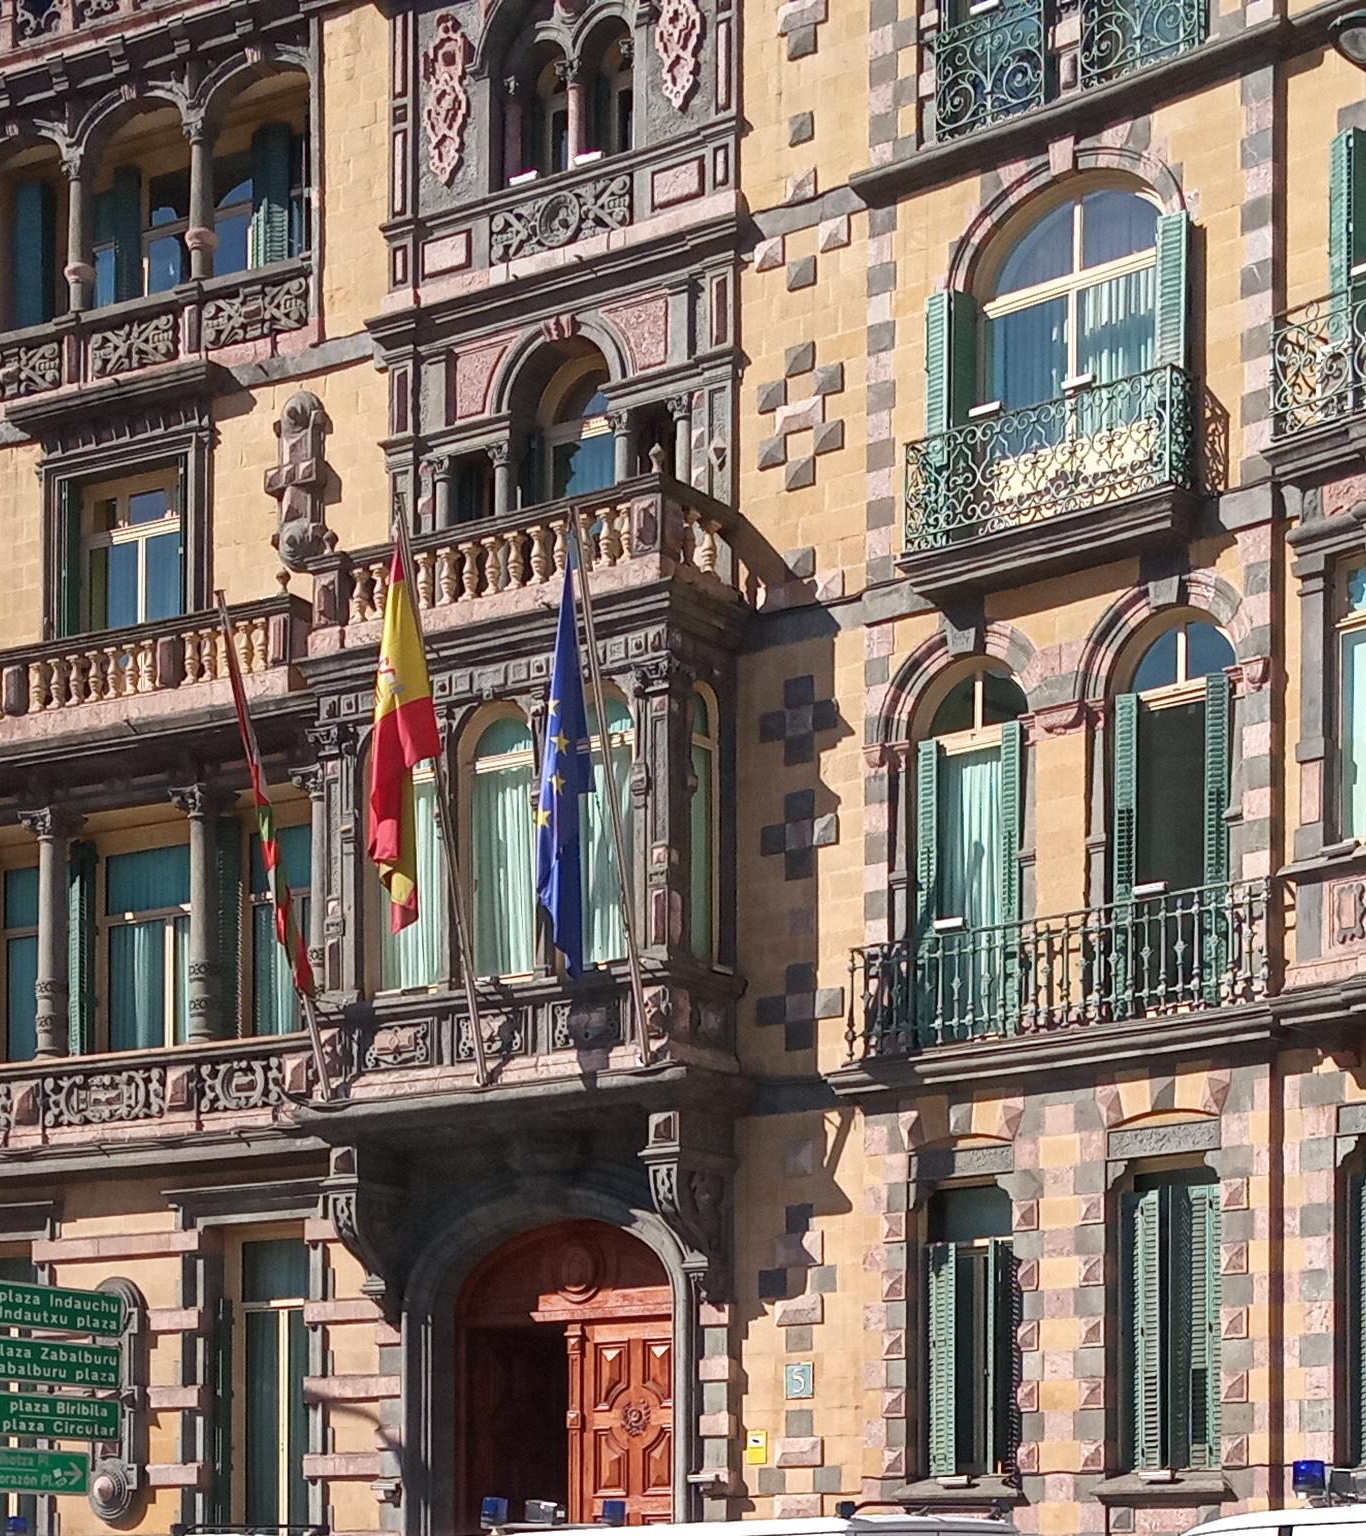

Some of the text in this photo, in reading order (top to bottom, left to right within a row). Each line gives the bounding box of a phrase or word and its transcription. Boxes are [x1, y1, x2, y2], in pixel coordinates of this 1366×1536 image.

[49, 1294, 118, 1313] Indauchu
[76, 1314, 117, 1330] plaza
[40, 1347, 117, 1366] Zabalburu
[75, 1367, 116, 1382] plaza
[792, 1368, 805, 1393] 5
[9, 1399, 108, 1417] plaza Biribila
[2, 1418, 115, 1436] plaza Circular
